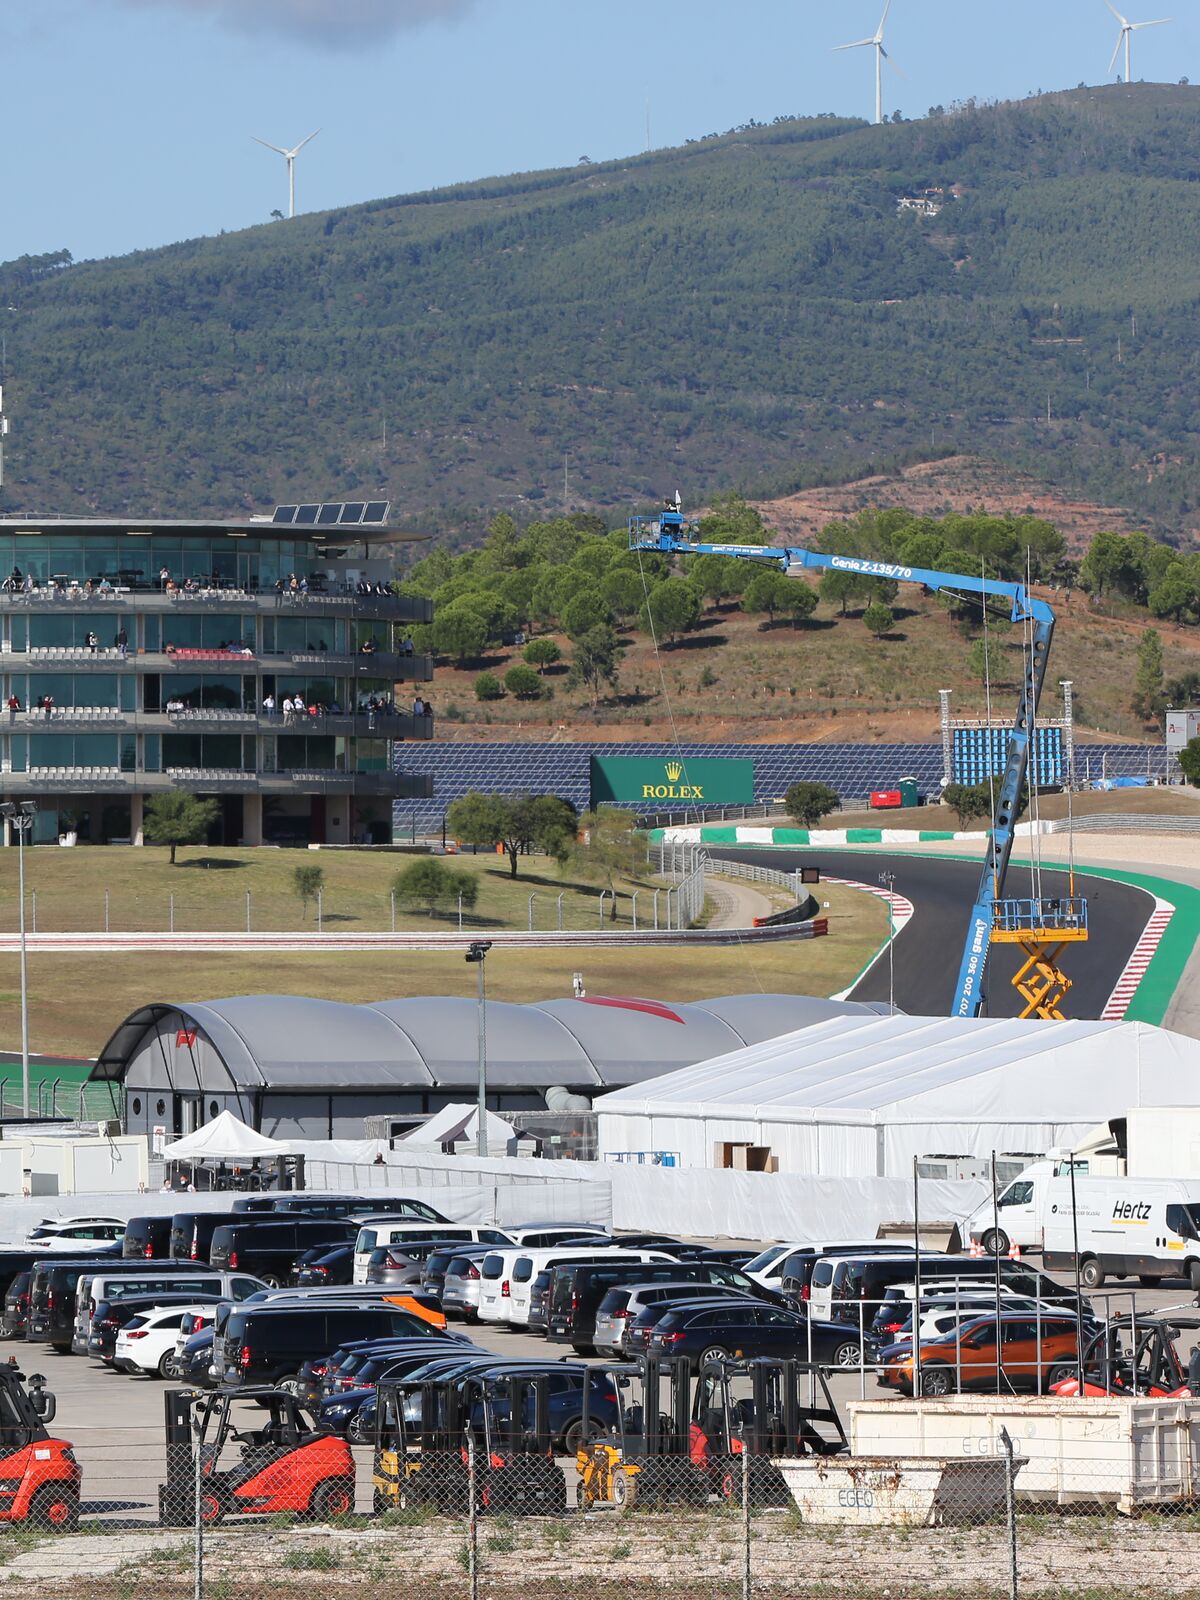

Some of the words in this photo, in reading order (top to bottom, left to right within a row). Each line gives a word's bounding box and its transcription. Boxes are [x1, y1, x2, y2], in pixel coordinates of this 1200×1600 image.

[831, 556, 860, 570] Genie
[861, 561, 912, 578] Z-135/70
[642, 785, 704, 798] ROLEX
[968, 956, 978, 974] 360
[964, 977, 974, 996] 200
[959, 999, 969, 1016] 707
[1112, 1200, 1152, 1220] Hertz
[838, 1490, 873, 1507] EGEO
